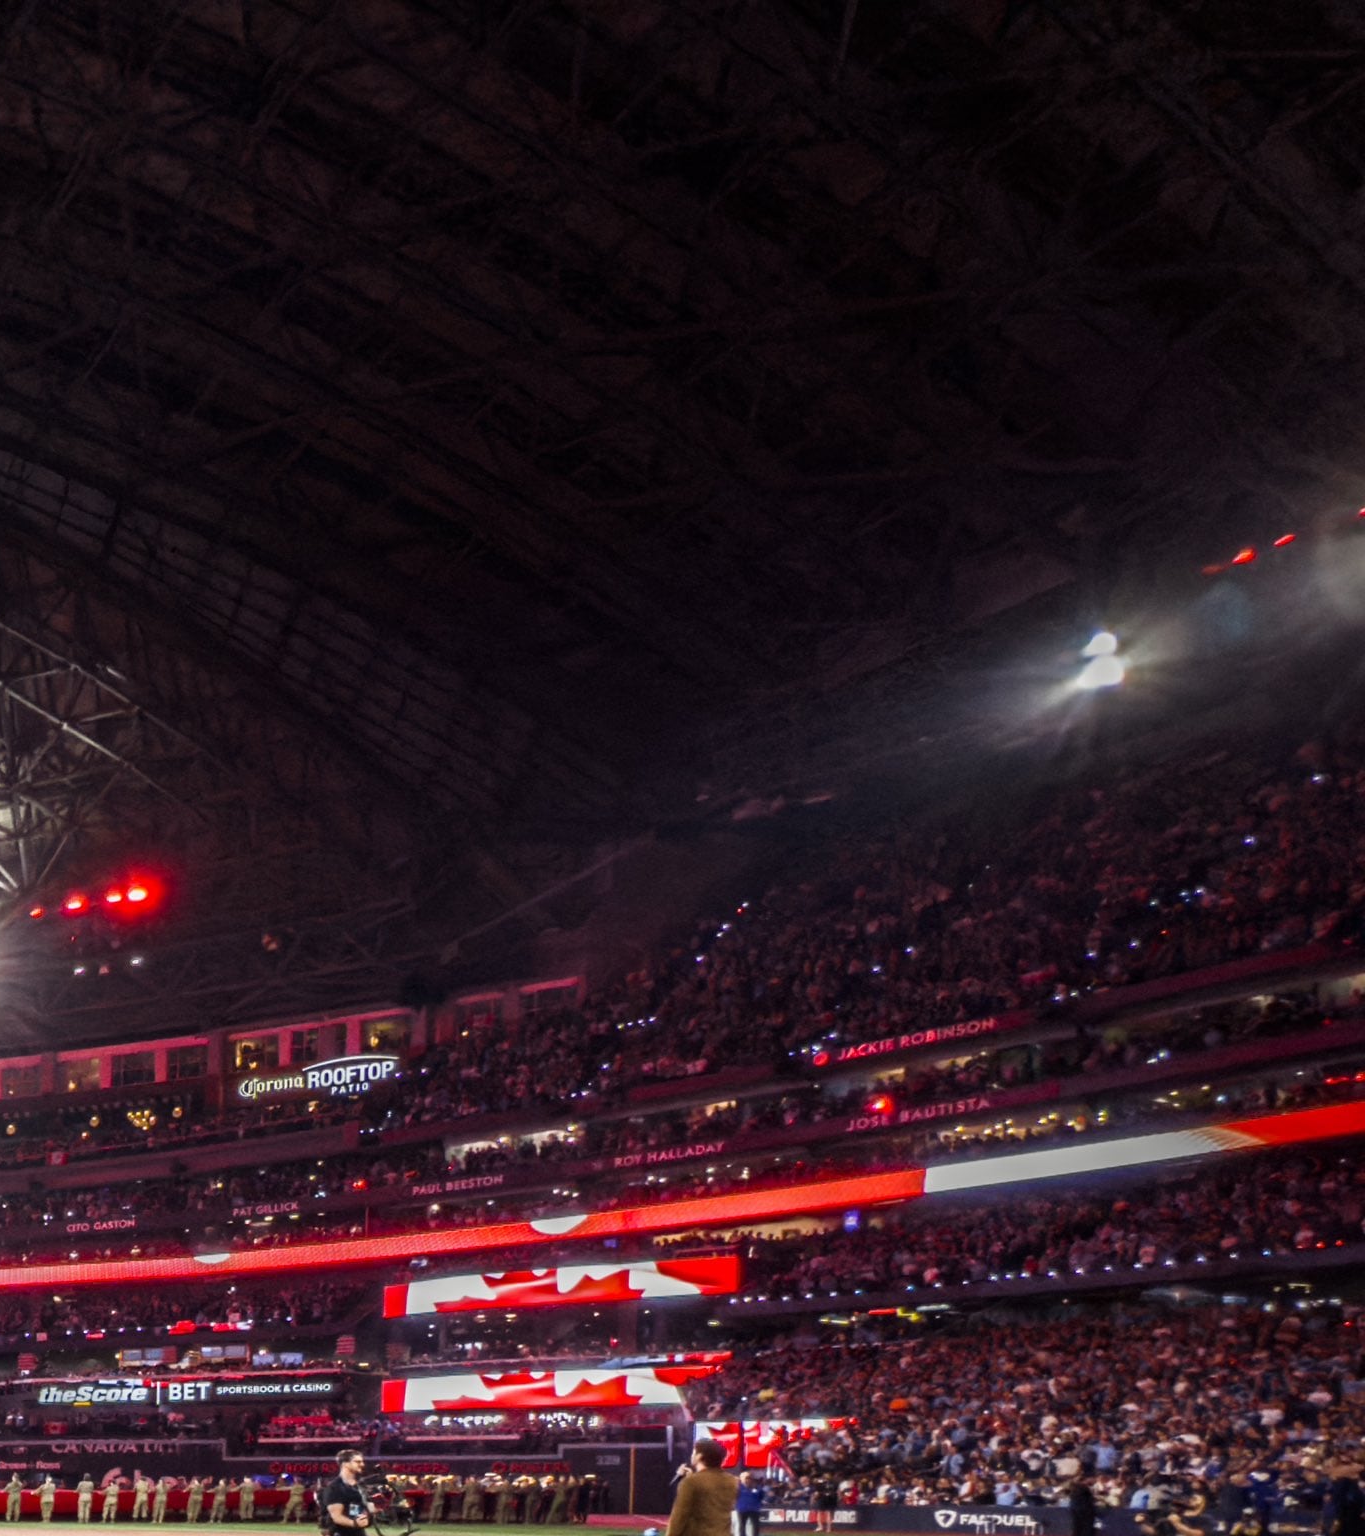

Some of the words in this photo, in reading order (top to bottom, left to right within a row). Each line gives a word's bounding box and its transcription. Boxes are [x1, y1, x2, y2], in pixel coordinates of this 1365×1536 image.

[838, 1038, 894, 1061] JACKIE
[900, 1017, 997, 1048] ROBINSON
[307, 1061, 394, 1089] ROOFTOP
[240, 1076, 304, 1098] Corona
[331, 1083, 369, 1095] PATIO
[900, 1098, 990, 1123] BAUTISTA
[614, 1154, 642, 1168] ROY
[647, 1141, 725, 1164] HALLADAY
[412, 1182, 442, 1196] PAUL
[445, 1174, 504, 1192] BEESTON
[232, 1206, 252, 1217] PAT
[255, 1202, 299, 1215] GILLICK
[66, 1223, 90, 1233] CITO
[93, 1219, 136, 1231] GASTON
[39, 1386, 148, 1404] theScore
[169, 1382, 211, 1400] BET
[217, 1385, 281, 1395] SPORTSBOOK
[283, 1385, 291, 1393] &
[293, 1383, 331, 1393] CASINO
